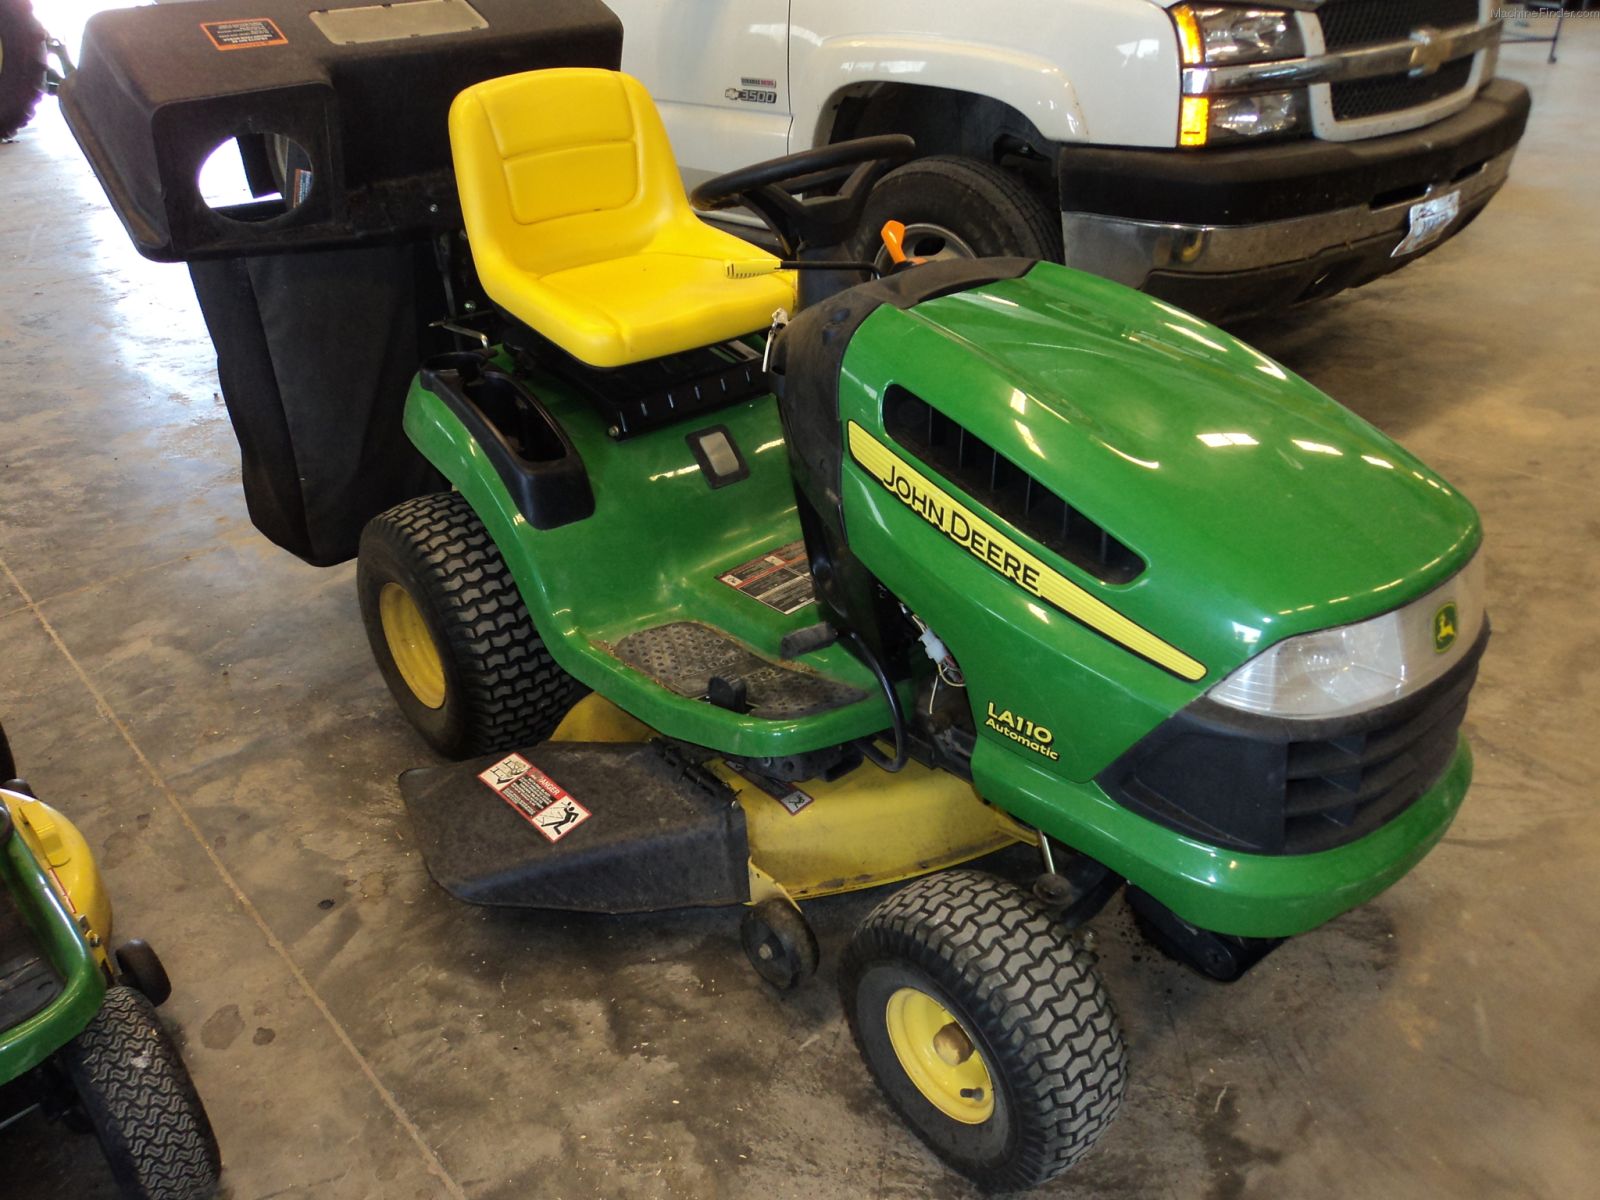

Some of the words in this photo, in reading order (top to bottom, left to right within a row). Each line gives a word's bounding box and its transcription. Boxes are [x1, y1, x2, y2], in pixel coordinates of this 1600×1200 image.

[741, 89, 777, 104] 3500
[883, 465, 945, 527] JOHN
[950, 510, 1040, 592] DEERE
[985, 718, 1059, 760] Automatic
[987, 701, 1053, 743] LA110
